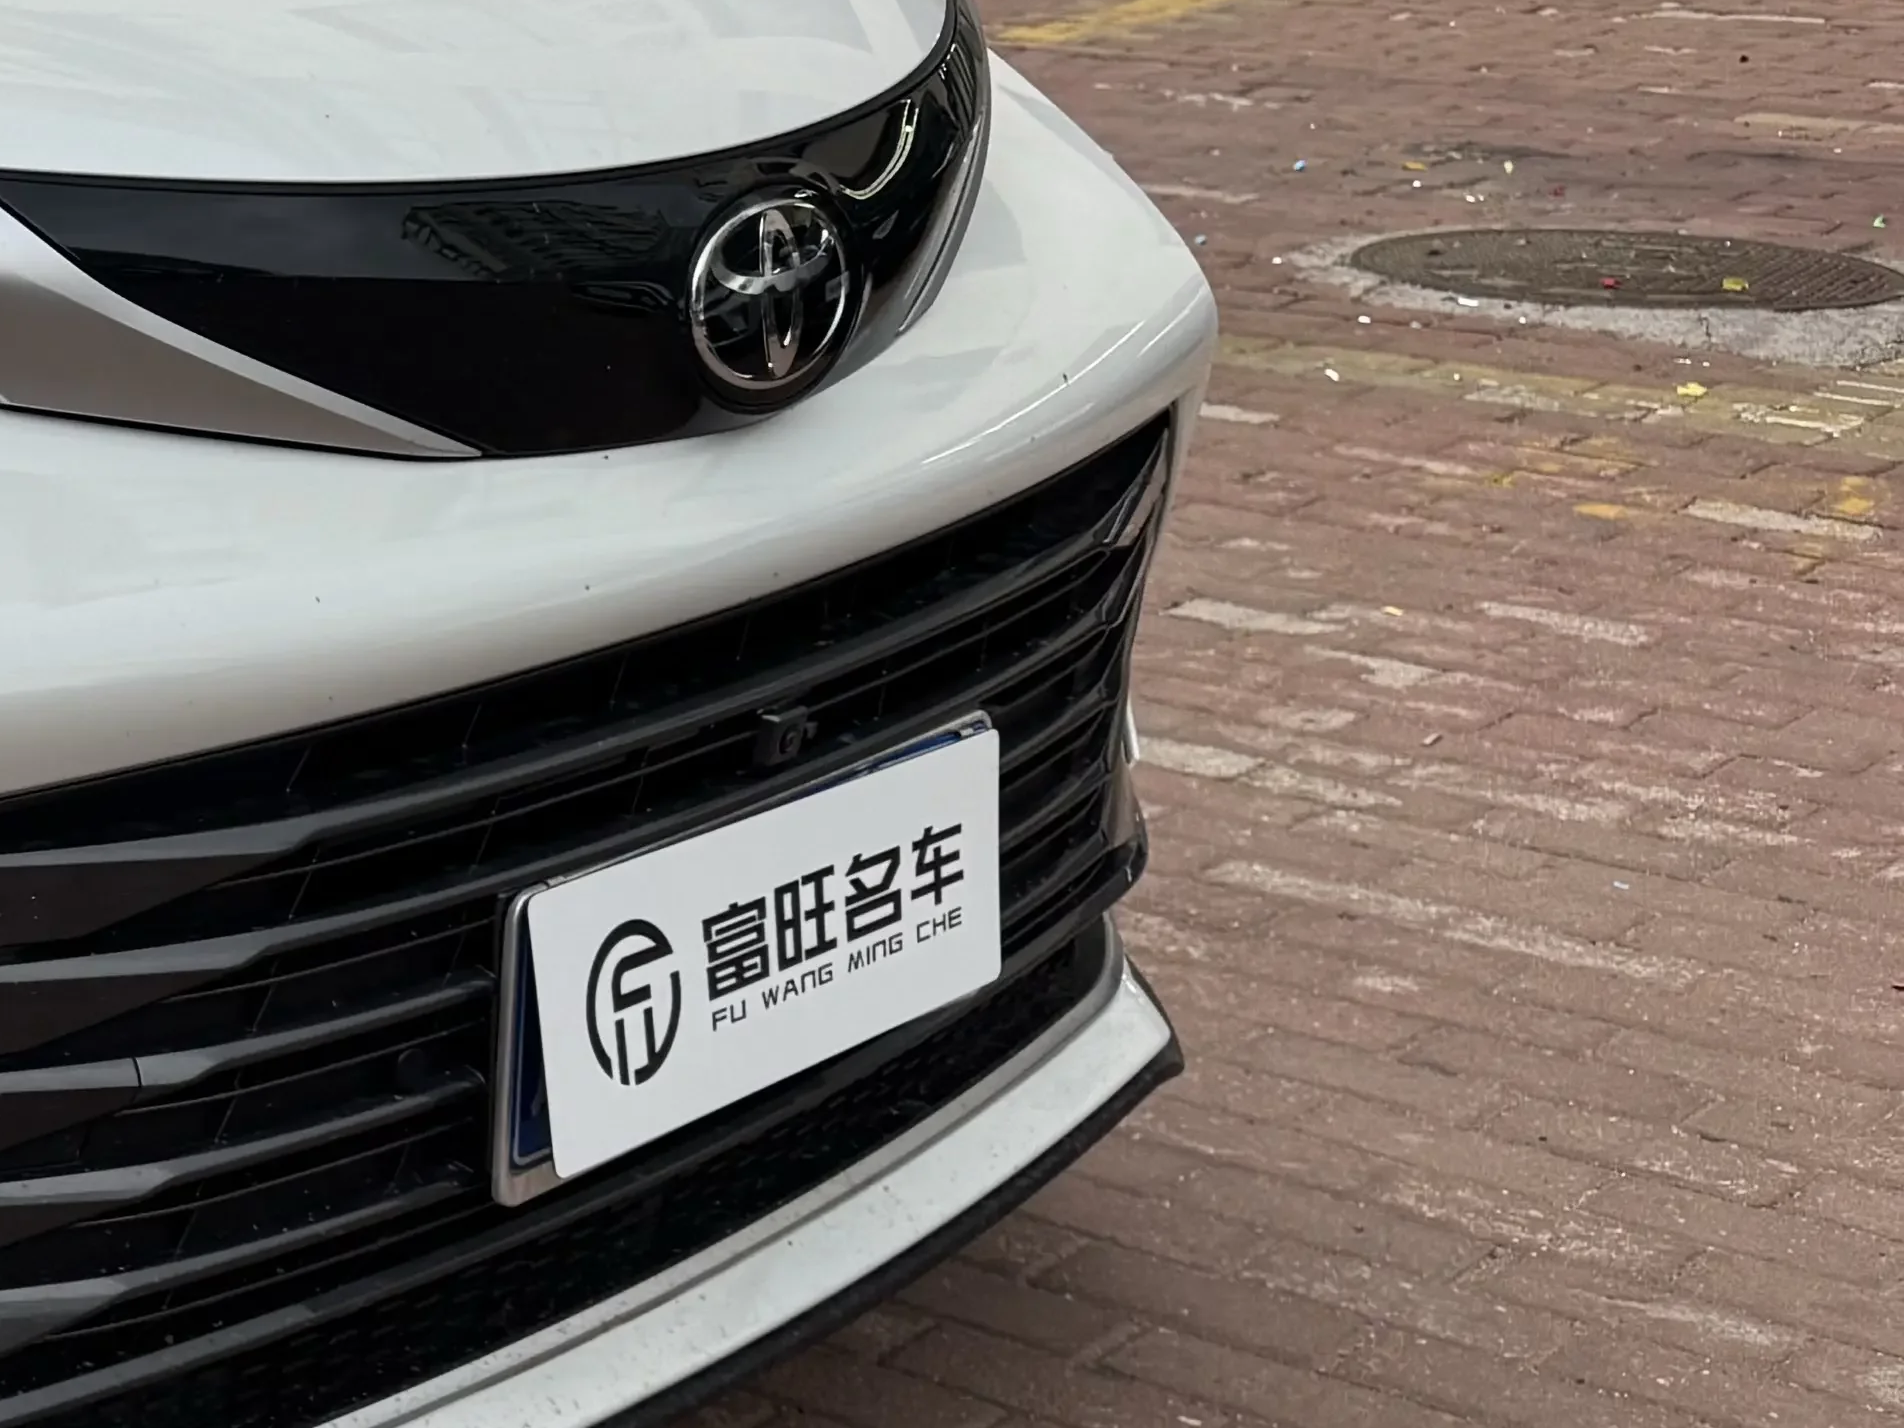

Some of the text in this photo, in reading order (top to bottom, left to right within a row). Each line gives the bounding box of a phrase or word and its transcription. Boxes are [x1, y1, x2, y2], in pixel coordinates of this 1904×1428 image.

[702, 822, 965, 1001] 富旺名车
[712, 907, 963, 1031] FU WANG MING CHE
